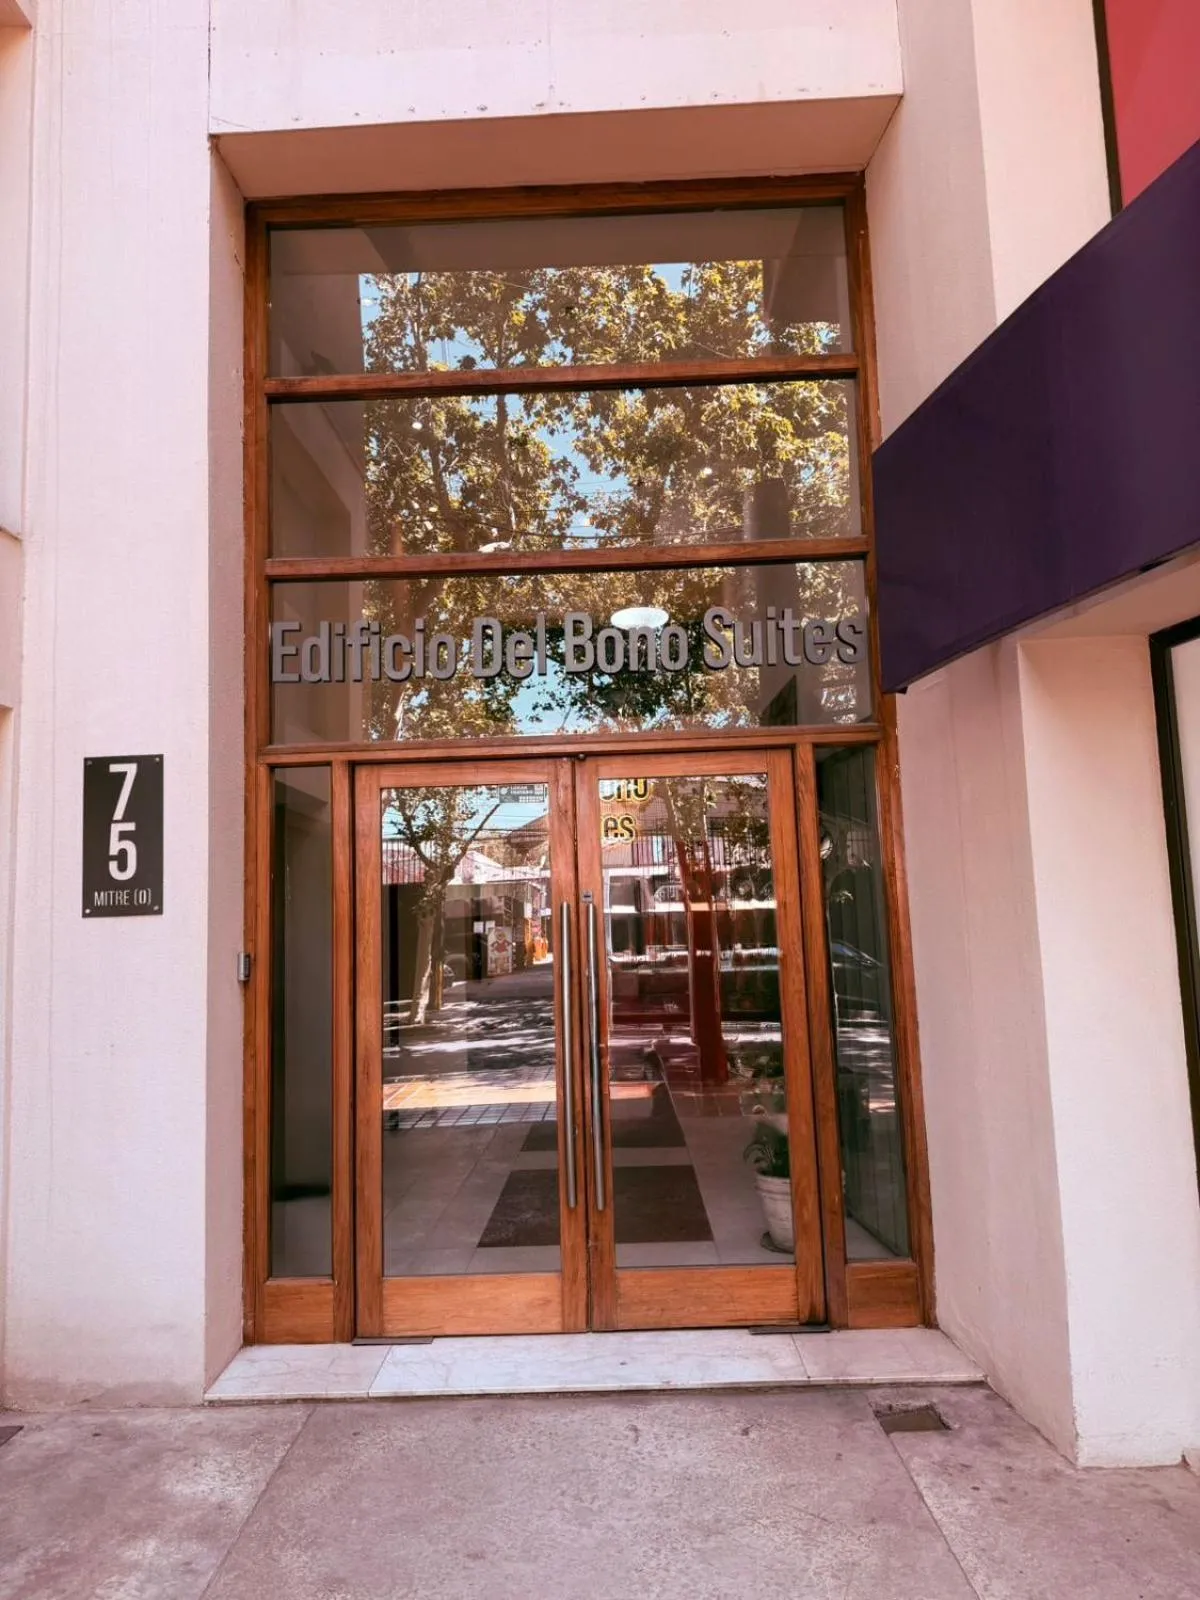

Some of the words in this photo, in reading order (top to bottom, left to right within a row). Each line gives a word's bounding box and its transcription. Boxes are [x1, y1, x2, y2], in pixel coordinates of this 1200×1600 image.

[272, 617, 459, 683] Edificio
[472, 611, 547, 679] Del
[564, 611, 689, 674] Bono
[702, 606, 868, 671] Suites
[94, 889, 131, 907] MITRE
